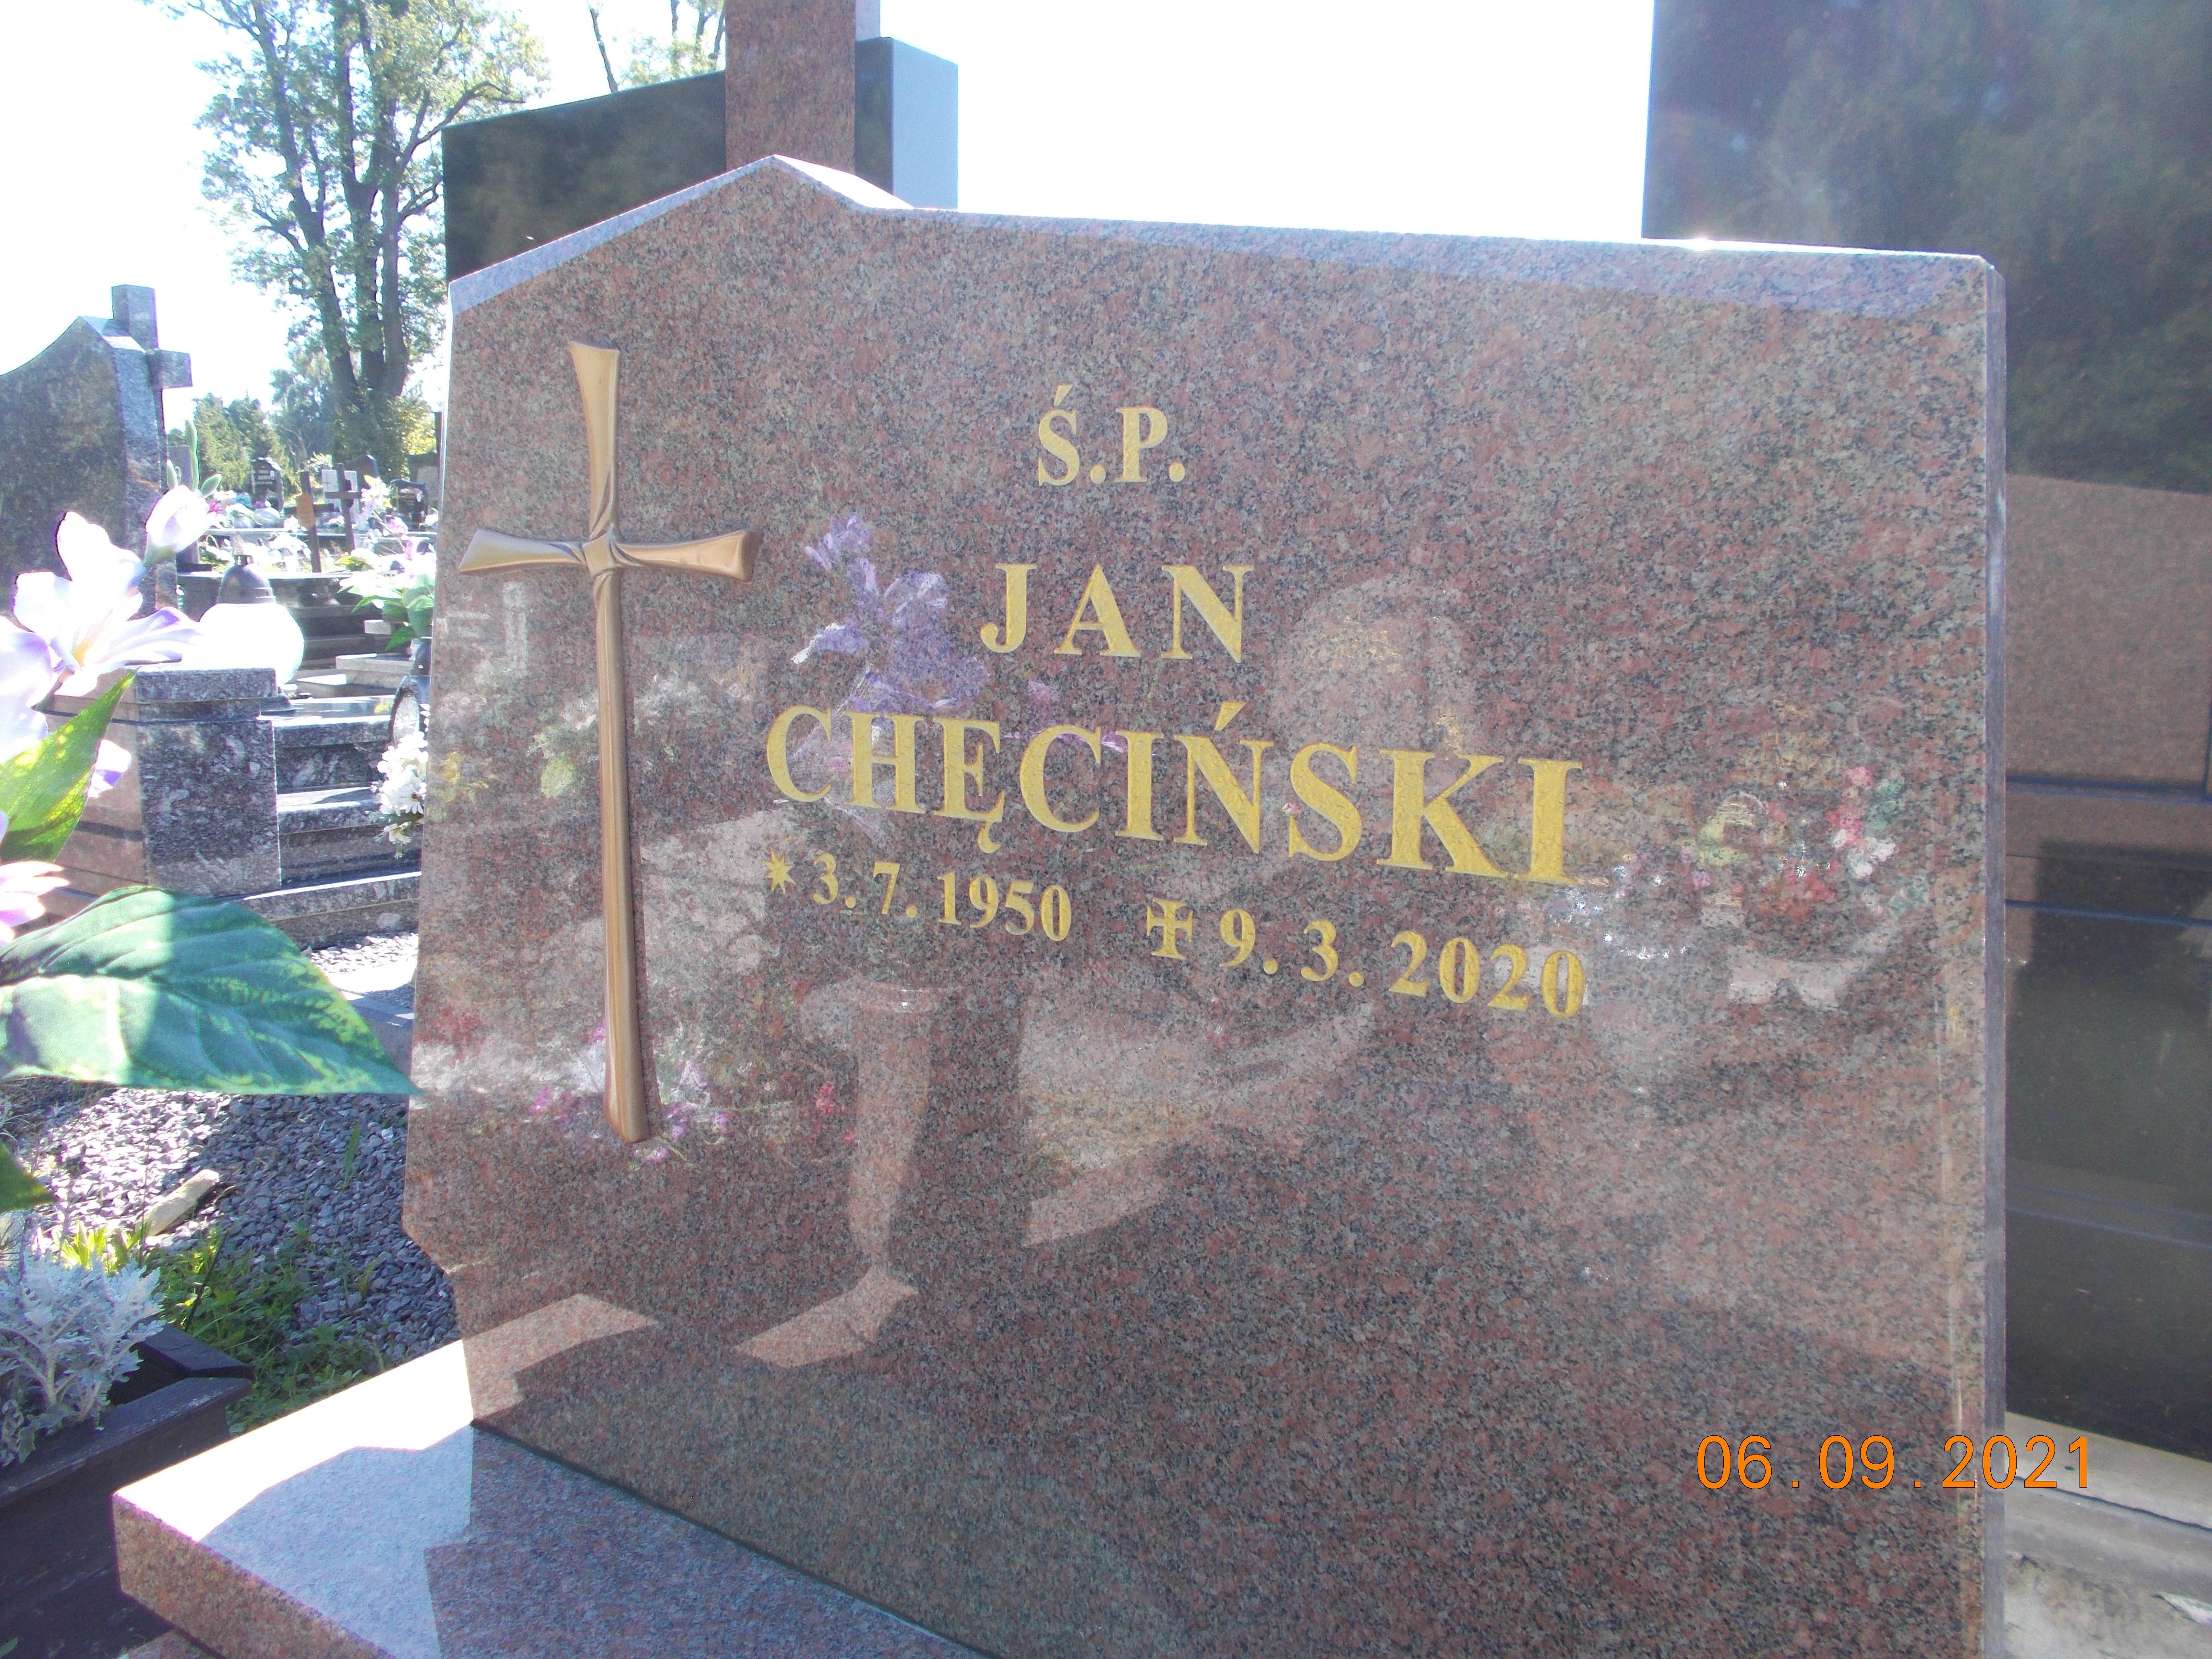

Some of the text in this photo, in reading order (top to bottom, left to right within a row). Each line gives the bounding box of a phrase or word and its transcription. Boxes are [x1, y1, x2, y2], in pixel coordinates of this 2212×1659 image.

[1037, 384, 1186, 486] Ś.P.
[980, 564, 1255, 664] JAN
[766, 701, 1583, 885] CHĘCIŃSKI
